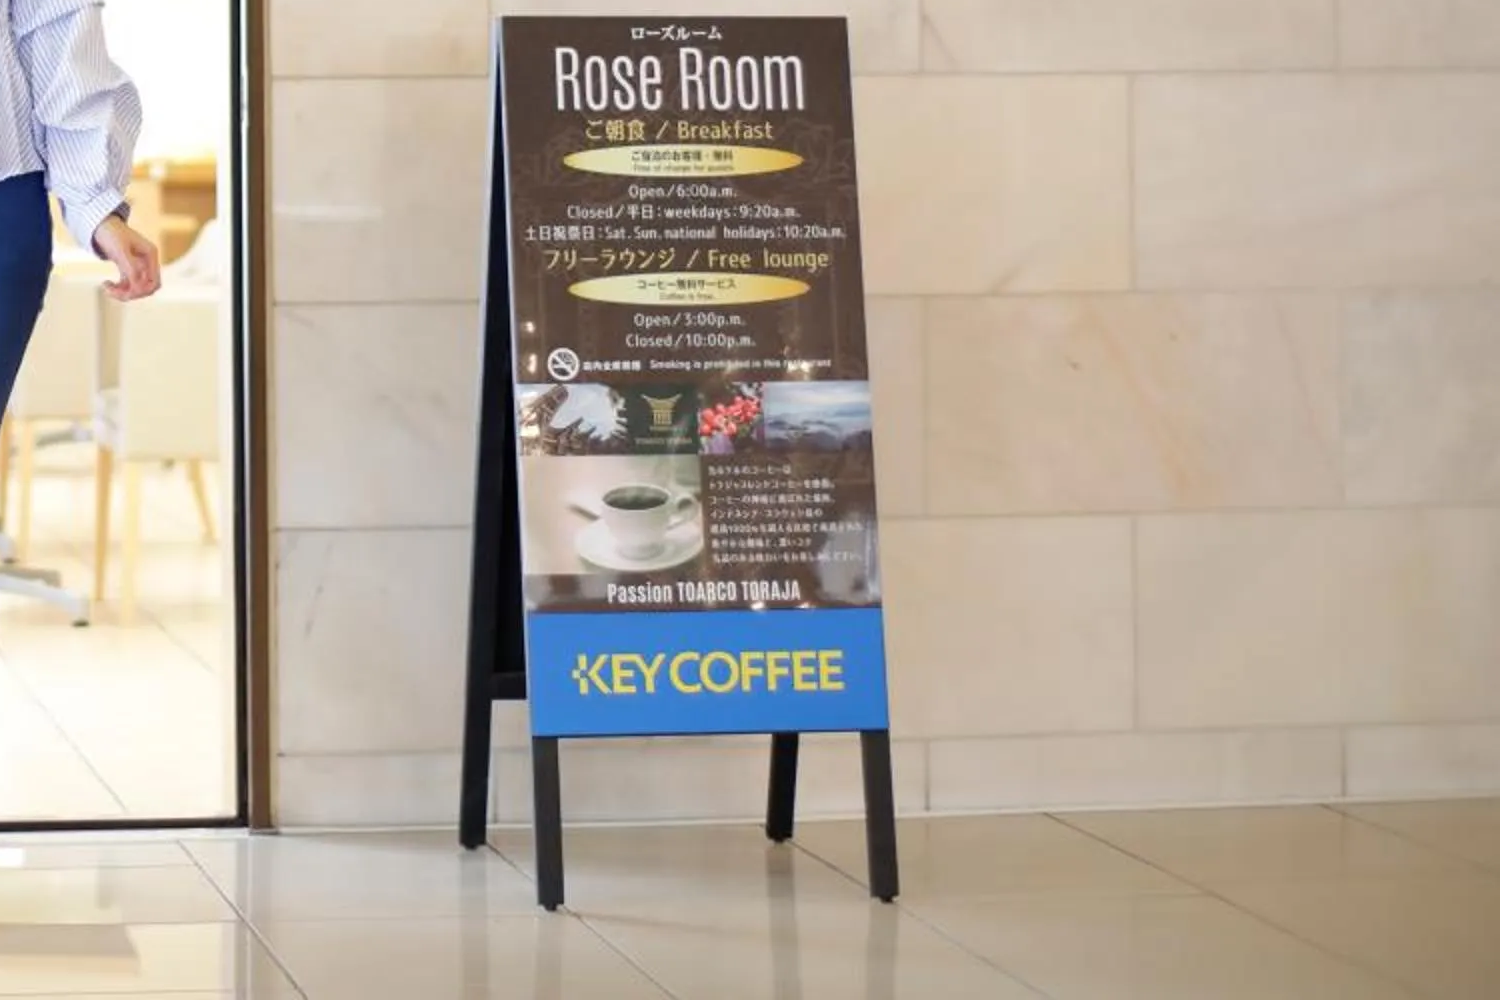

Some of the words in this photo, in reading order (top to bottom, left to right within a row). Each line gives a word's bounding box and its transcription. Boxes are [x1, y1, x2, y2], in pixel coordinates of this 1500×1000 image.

[630, 26, 723, 41] ローズルーム
[555, 47, 663, 111] Rose
[679, 47, 805, 111] Room
[585, 119, 646, 141] ご朝食
[677, 120, 774, 140] Breakfast
[545, 247, 676, 270] フリーラウンジ
[708, 250, 751, 269] Free
[763, 247, 829, 272] lounge
[607, 582, 672, 603] Passion
